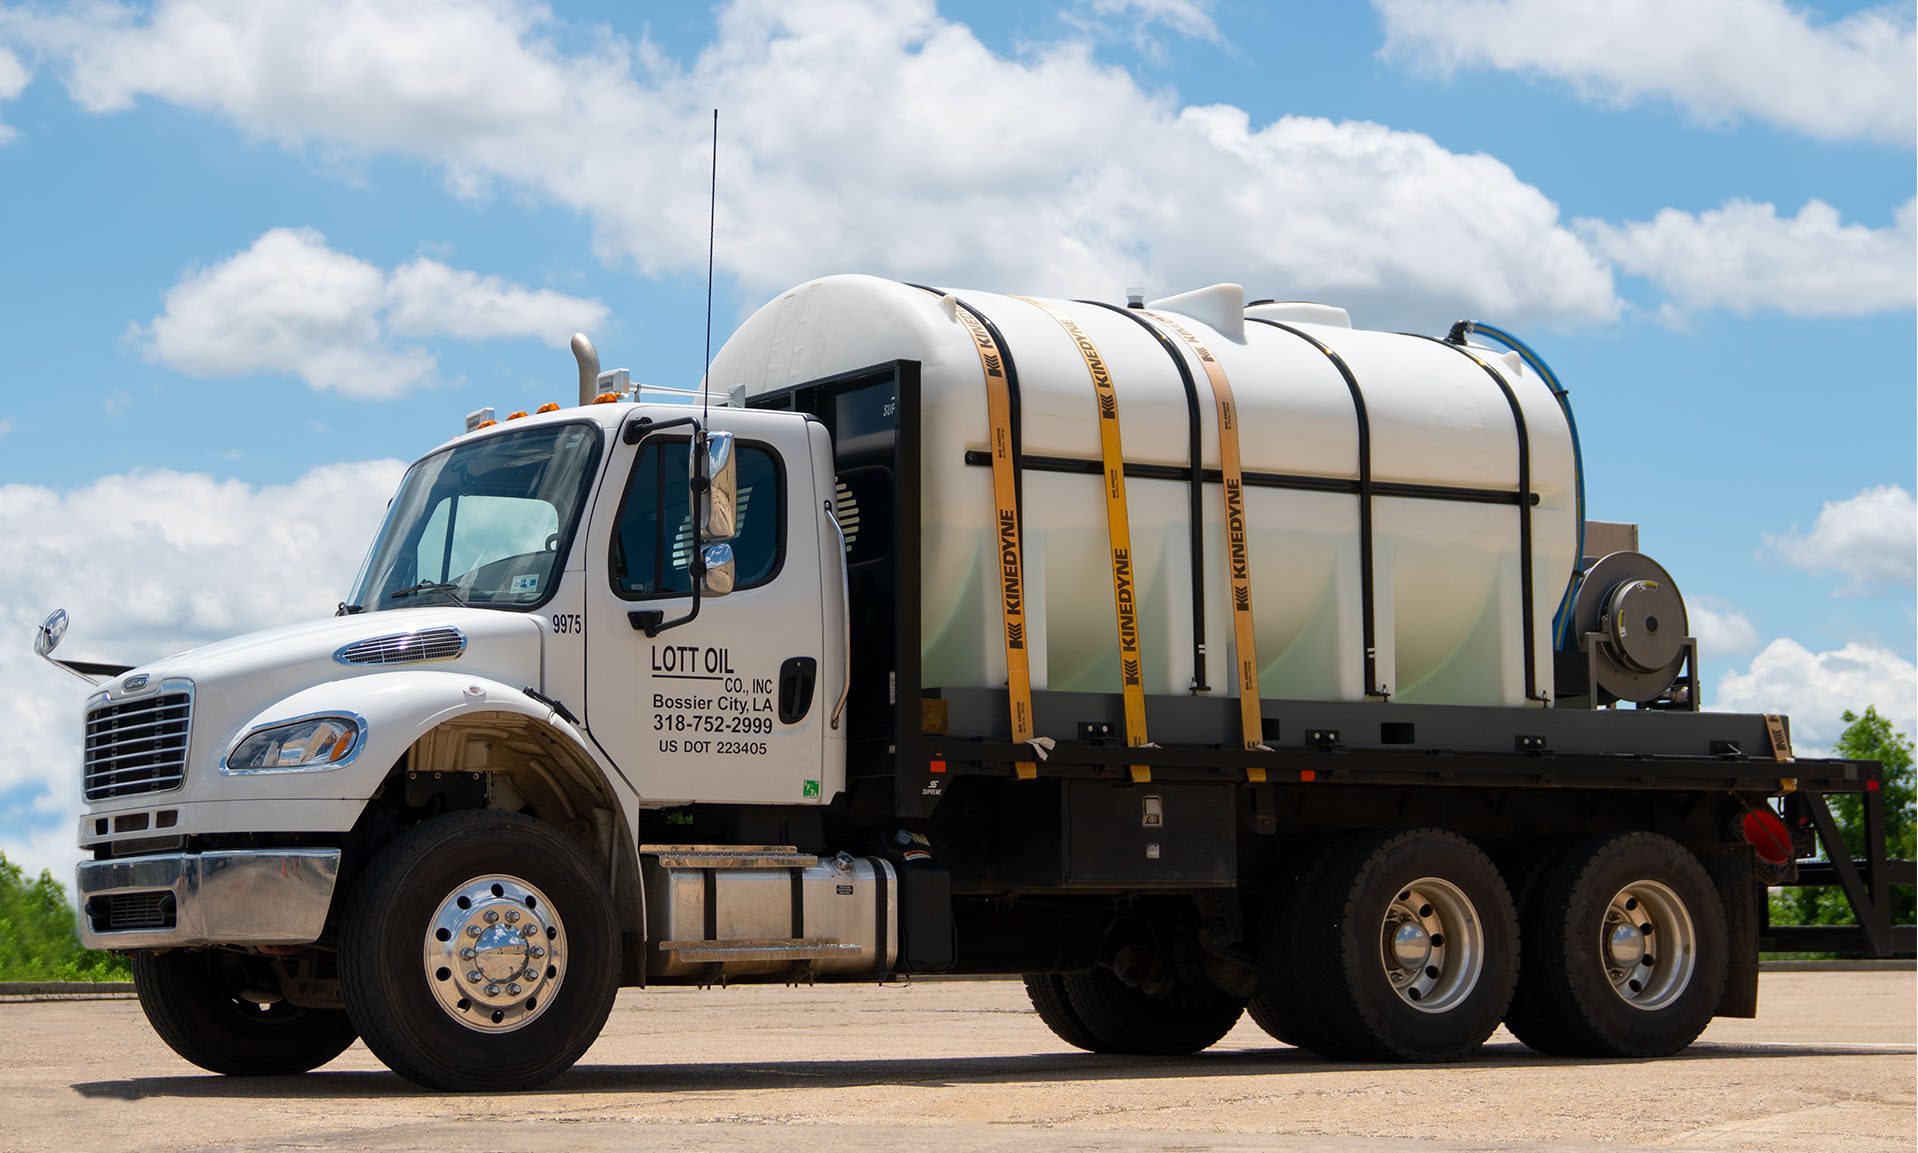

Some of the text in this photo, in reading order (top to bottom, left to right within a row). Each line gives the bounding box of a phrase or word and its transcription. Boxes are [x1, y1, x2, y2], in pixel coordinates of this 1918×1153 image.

[1061, 319, 1111, 388] KINEDYNE
[1226, 478, 1247, 579] KINEDYNE
[1000, 509, 1021, 615] KINEDYNE
[1114, 548, 1136, 652] KINEDYNE
[553, 614, 581, 634] 9975
[652, 645, 734, 674] LOTT OIL
[725, 677, 773, 696] CO., INC
[653, 694, 773, 715] Bossier City, LA
[653, 714, 773, 734] 318-752-2999
[659, 740, 767, 755] US DOT 223405
